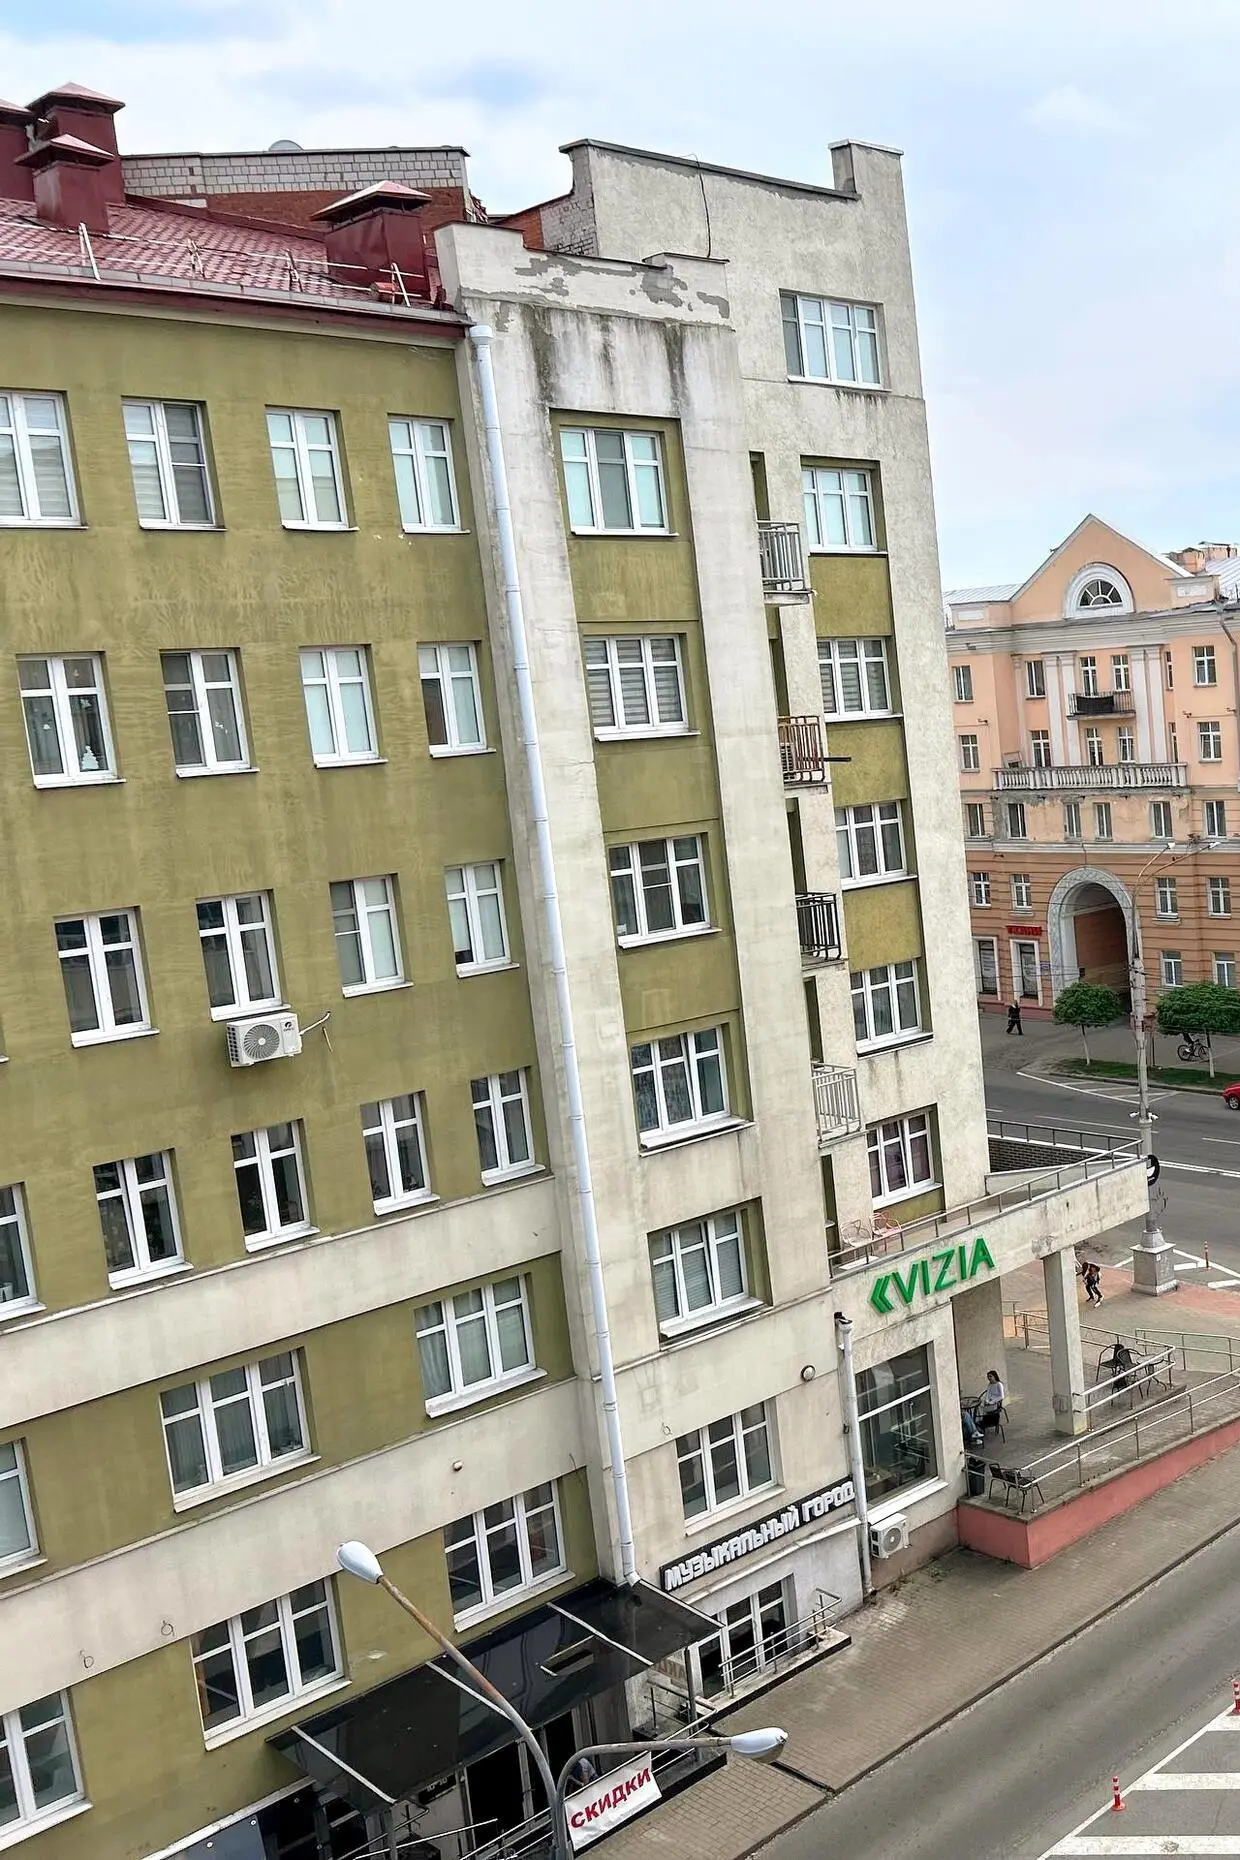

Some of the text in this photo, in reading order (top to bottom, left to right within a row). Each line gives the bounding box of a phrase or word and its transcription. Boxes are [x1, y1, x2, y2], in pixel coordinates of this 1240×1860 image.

[664, 1480, 856, 1592] МУЗЫКАЛЬНЫЙ ГОРОД
[570, 1767, 652, 1829] СКИДКИ
